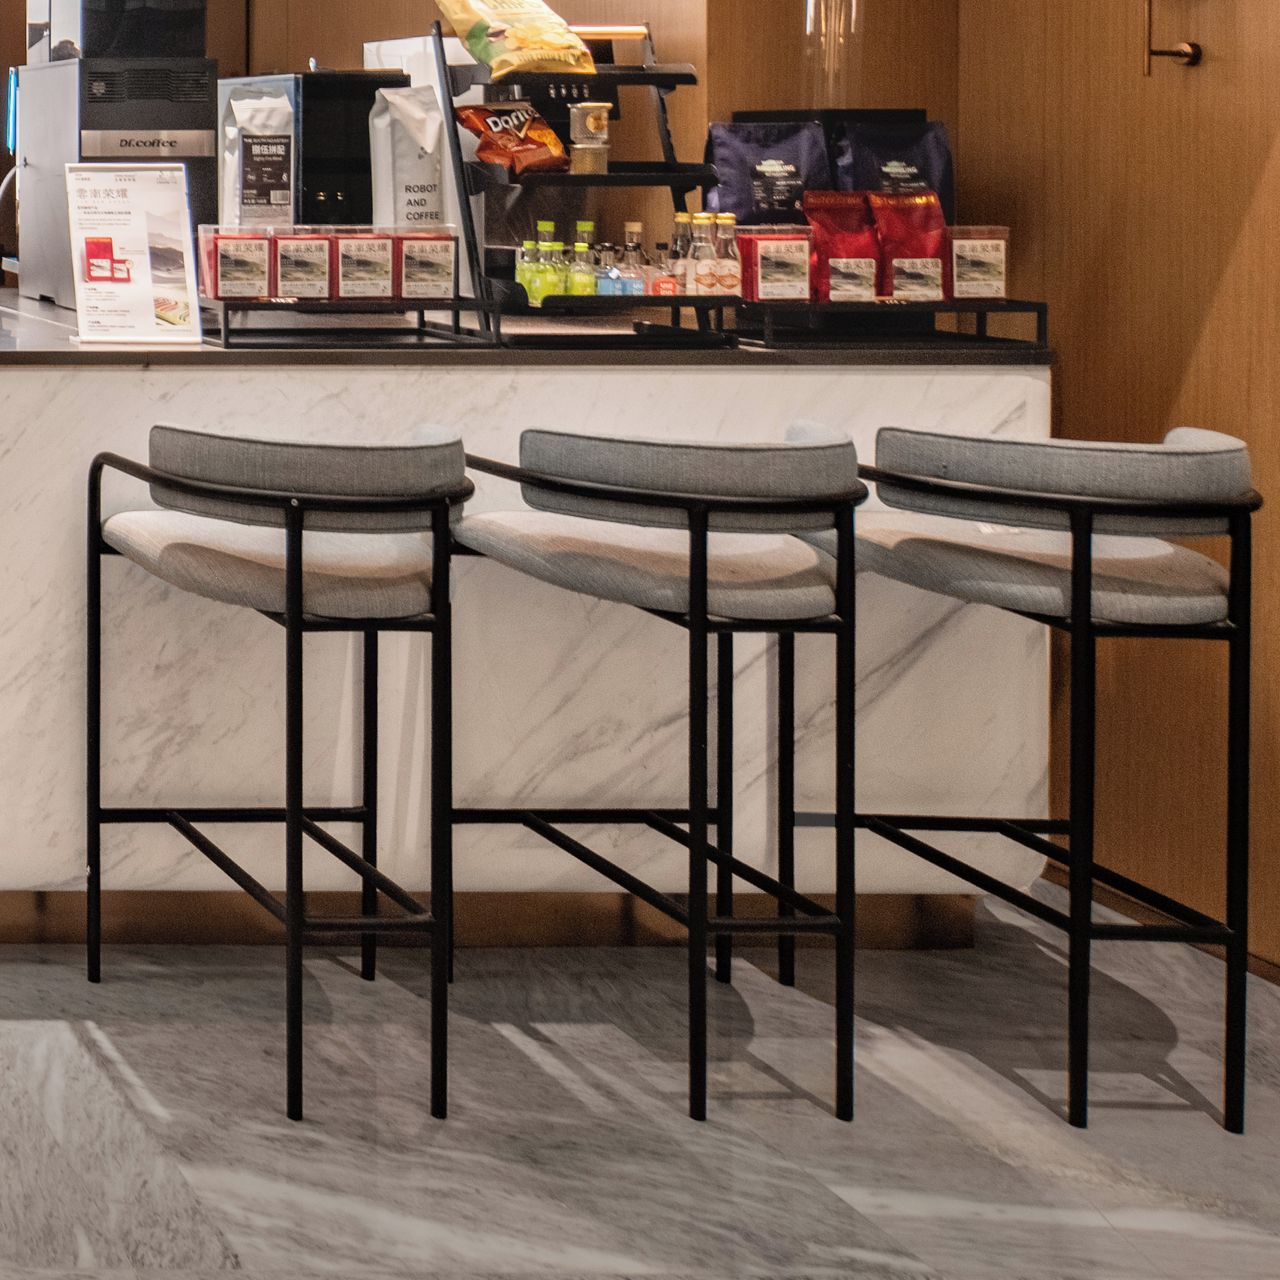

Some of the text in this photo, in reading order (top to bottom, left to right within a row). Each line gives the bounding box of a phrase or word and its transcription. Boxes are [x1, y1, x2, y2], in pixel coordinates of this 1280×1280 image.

[404, 184, 438, 193] ROBOT
[406, 198, 427, 207] AND
[406, 211, 440, 221] COFFEE
